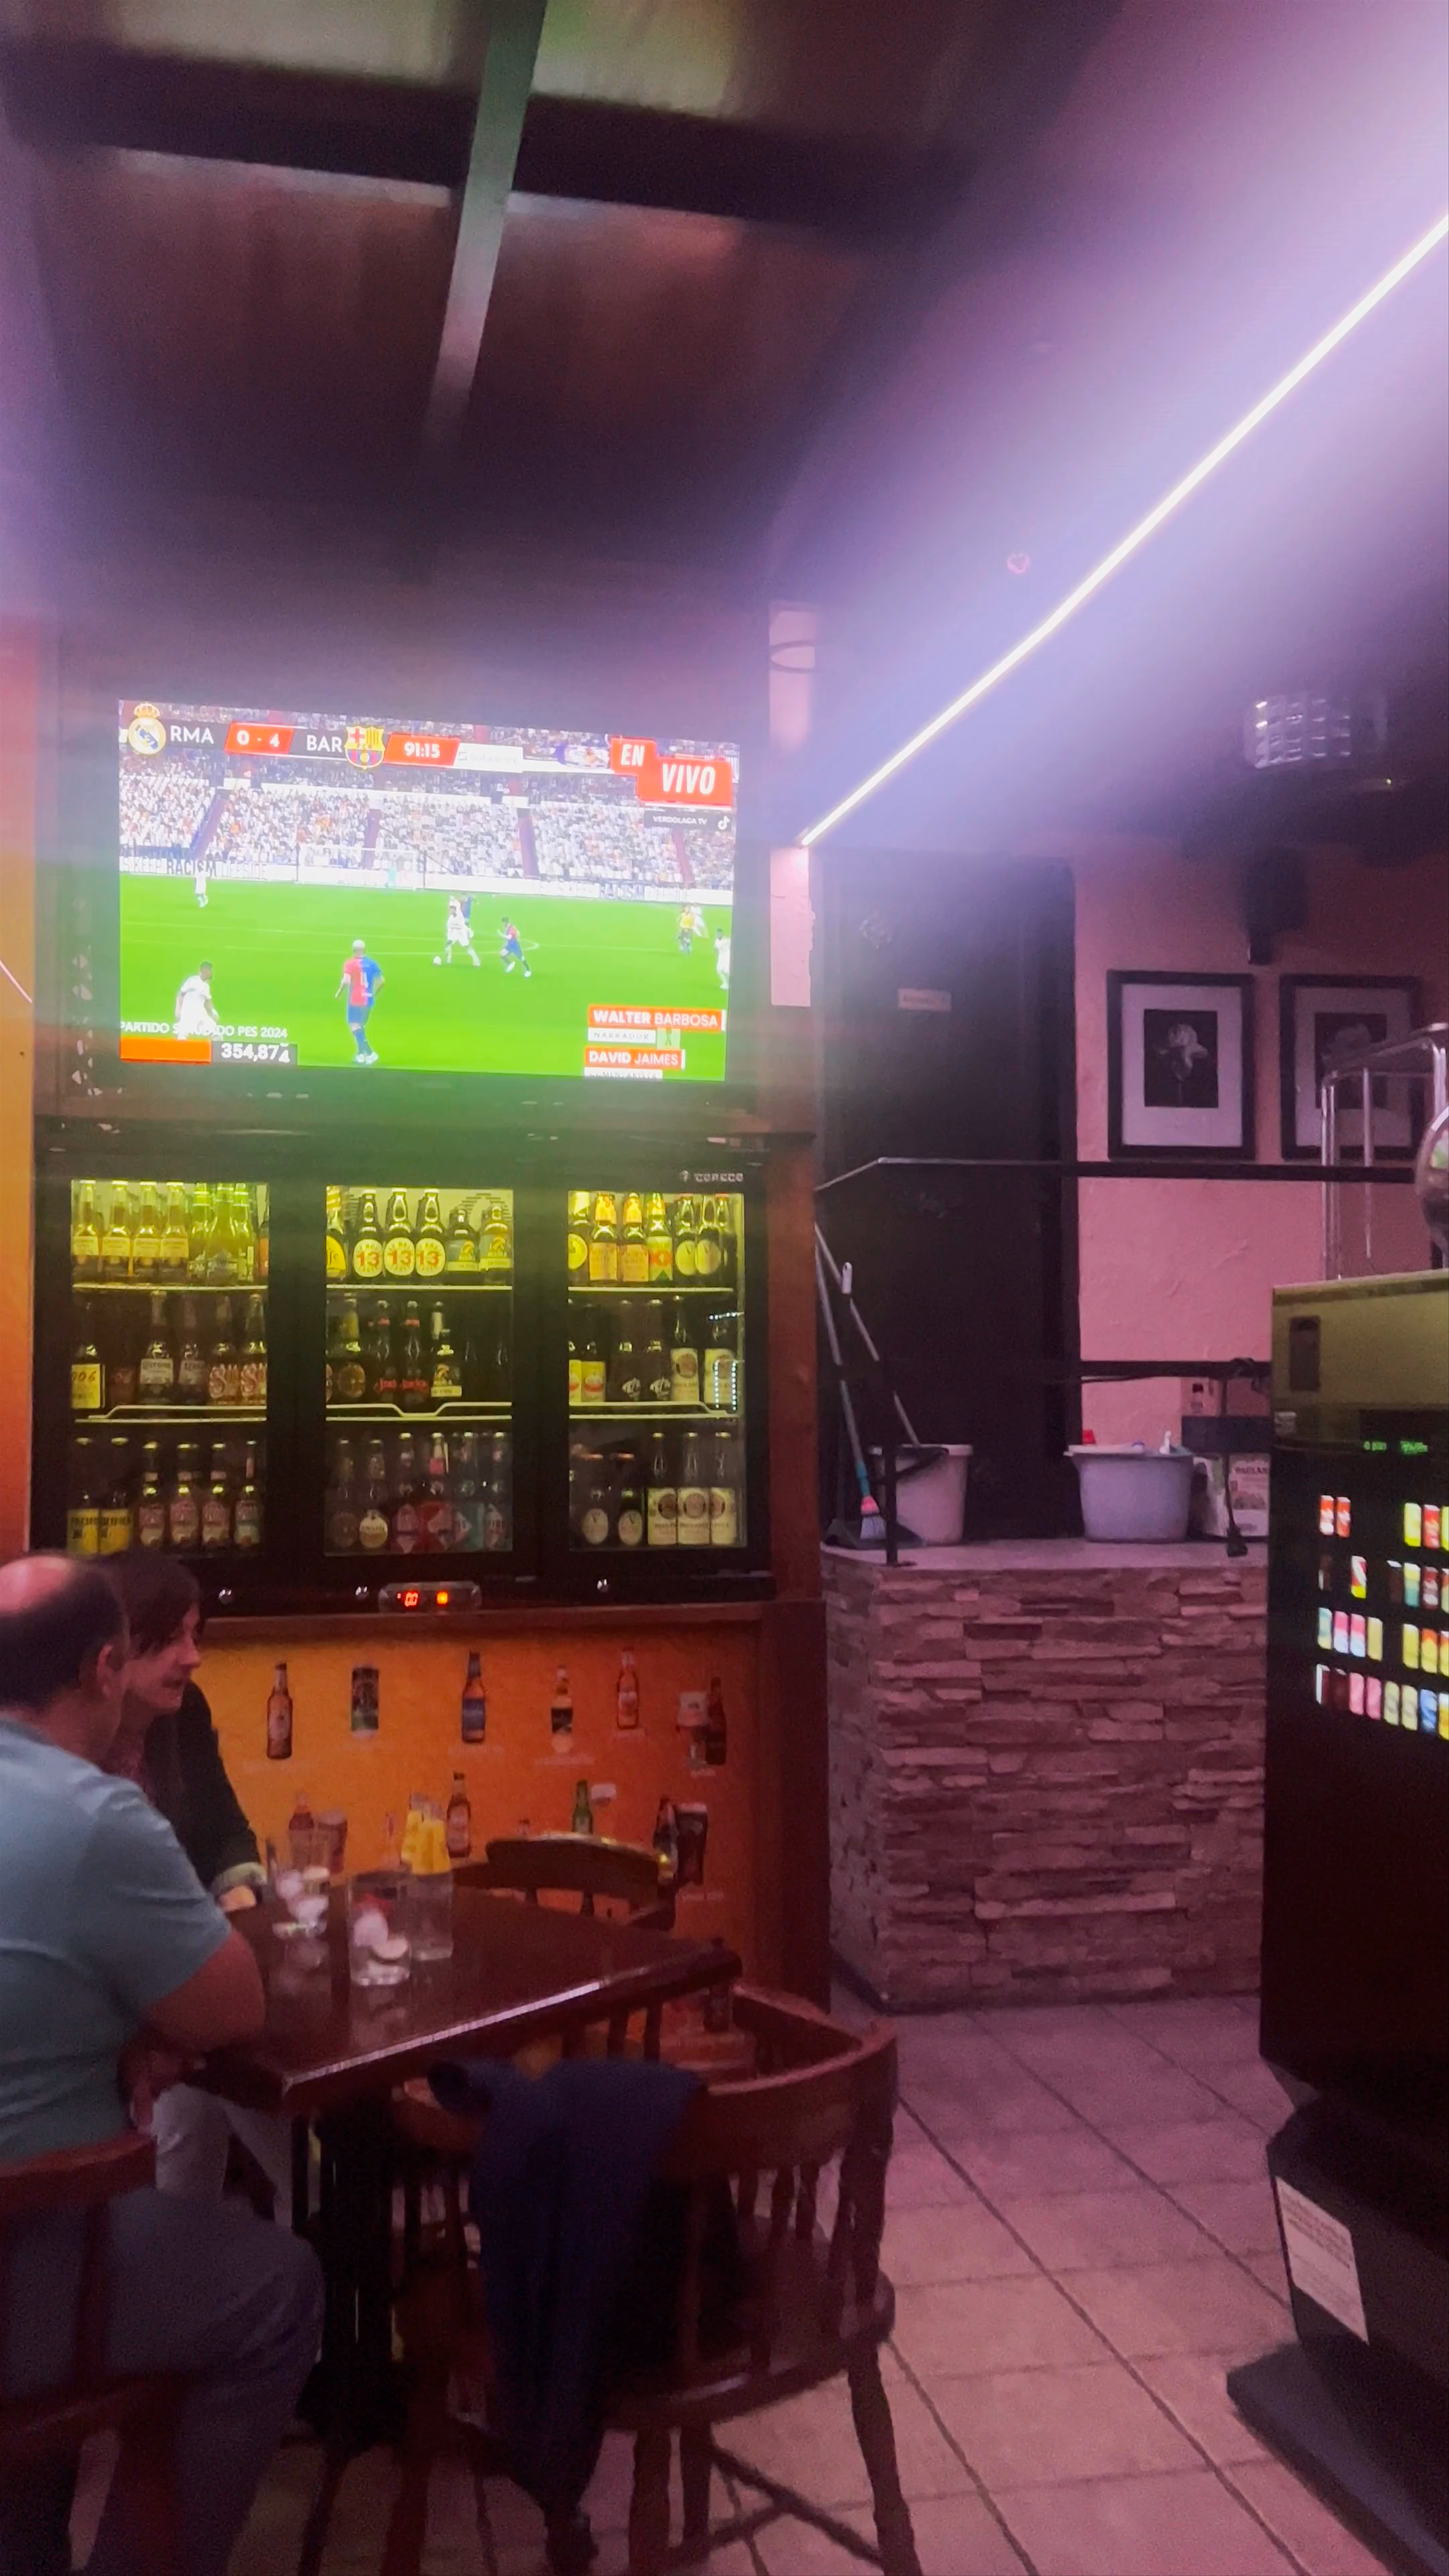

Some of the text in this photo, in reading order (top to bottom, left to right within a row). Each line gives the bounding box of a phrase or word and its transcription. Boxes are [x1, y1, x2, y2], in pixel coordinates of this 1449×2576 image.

[171, 726, 214, 744] RMA
[237, 731, 249, 746] 0
[269, 734, 280, 747] 4
[307, 736, 342, 752] BAR
[405, 741, 440, 758] 91:15
[621, 744, 645, 766] EN
[662, 764, 715, 794] VIVO
[593, 1010, 718, 1026] WALTER BARBOSA
[238, 1026, 258, 1037] PES
[260, 1027, 288, 1038] 2024
[589, 1051, 678, 1066] DAVID JAIMES
